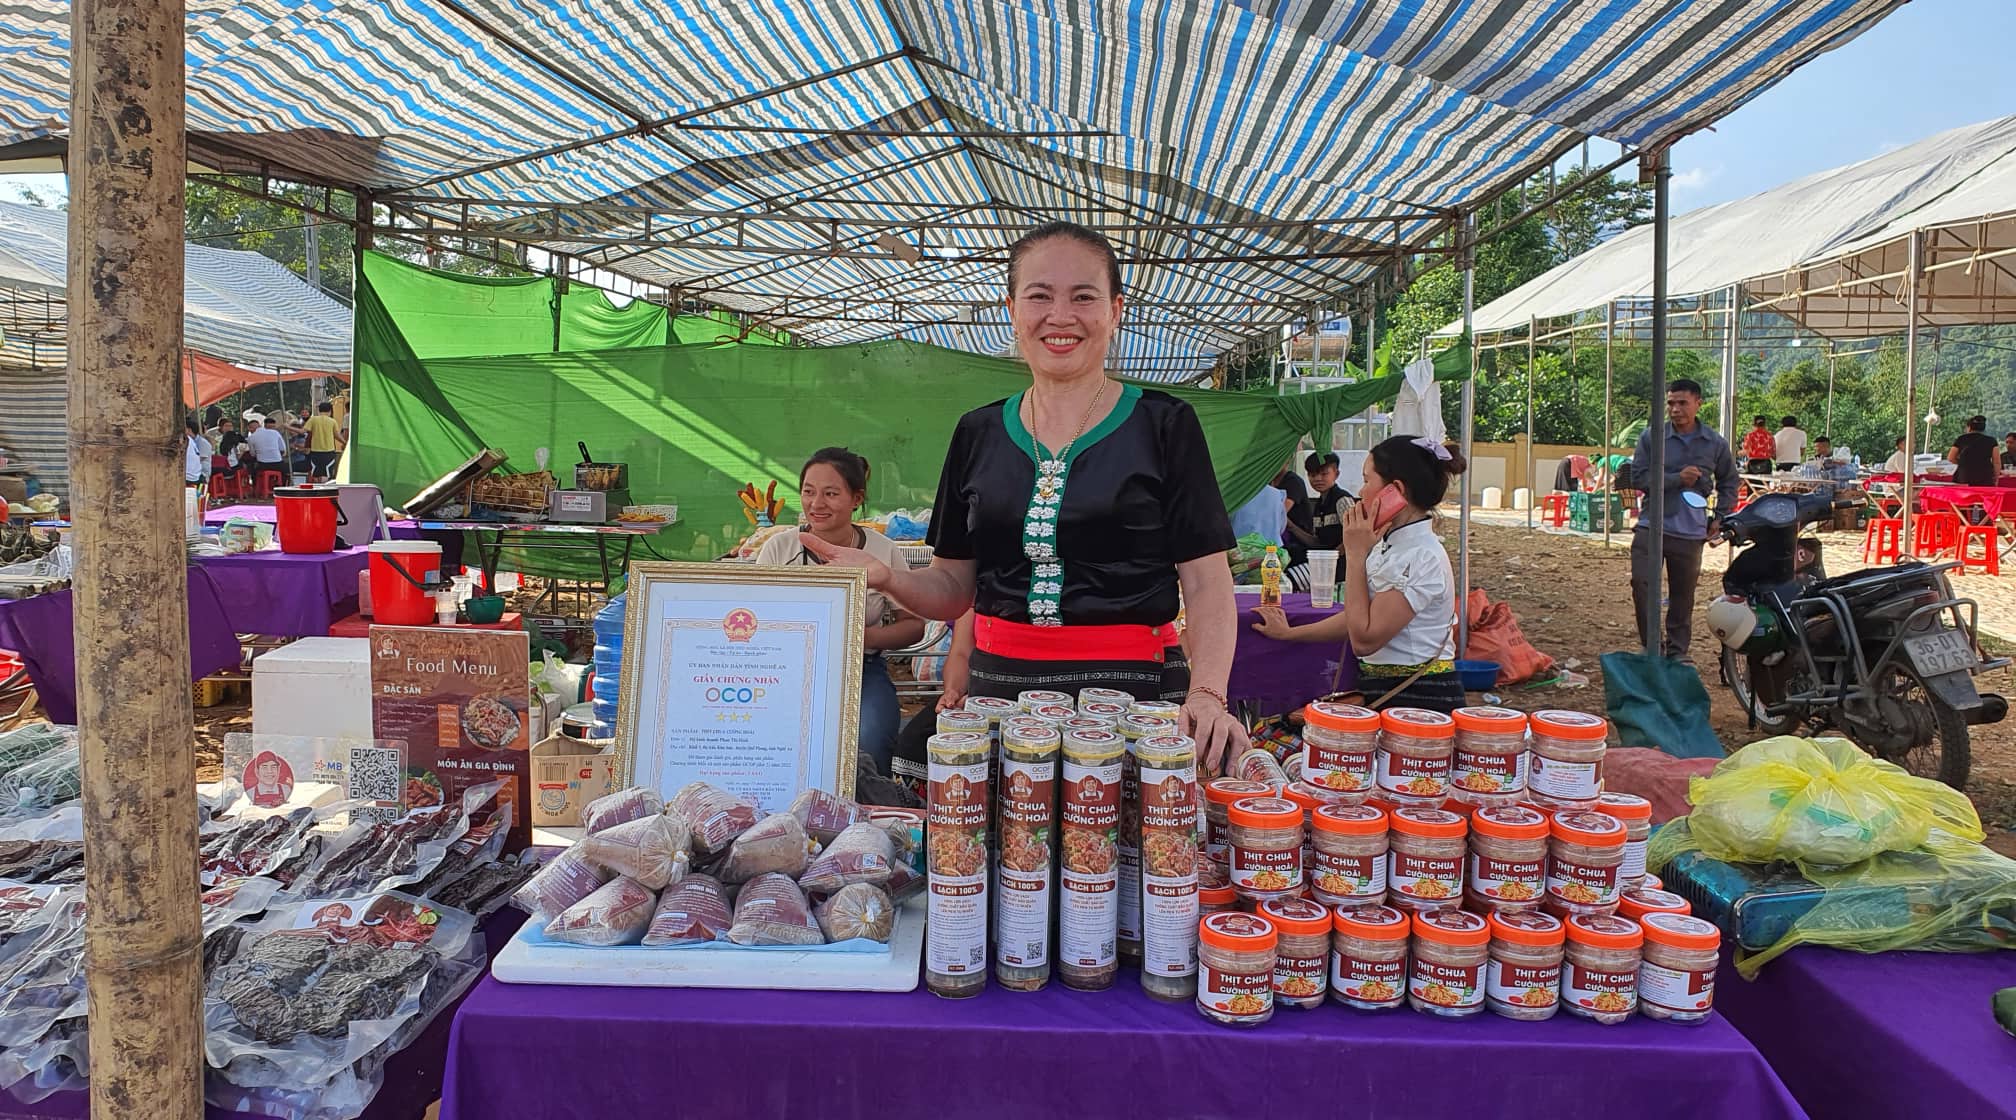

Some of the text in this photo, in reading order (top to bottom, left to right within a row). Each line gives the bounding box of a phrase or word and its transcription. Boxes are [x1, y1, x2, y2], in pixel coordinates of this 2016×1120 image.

[406, 658, 497, 676] Food Menu
[717, 675, 751, 684] CHỨNG
[754, 676, 780, 687] NHẬN
[383, 684, 421, 695] ĐẶC SẢN
[705, 687, 766, 703] OCOP
[1319, 751, 1366, 763] THỊT CHUA
[1459, 752, 1506, 765] THỊT CHUA
[327, 762, 343, 771] MB
[437, 758, 458, 769] MÓN
[475, 761, 490, 770] GIA
[493, 759, 515, 772] ĐÌNH
[1402, 758, 1447, 769] THỊT CHUA
[934, 804, 983, 816] THỊT CHUA
[1018, 802, 1046, 811] CHUA
[1066, 802, 1116, 815] THỊT CHUA
[1148, 803, 1195, 815] THỊT CHUA
[930, 812, 986, 825] CƯỜNG HOÀI
[1063, 812, 1119, 825] CƯỜNG HOÀI
[1244, 852, 1293, 863] THỊT CHUA
[1315, 851, 1360, 867] THỊT CHUA
[1405, 858, 1455, 870] THỊT CHUA
[1489, 861, 1539, 874] THỊT CHUA
[1557, 861, 1607, 878] THỊT CHUA
[959, 886, 978, 894] 100%
[1018, 882, 1037, 890] 100%
[1091, 883, 1109, 891] 100%
[1176, 886, 1194, 895] 100%
[1298, 957, 1322, 967] CHUA
[1351, 960, 1400, 973] THỊT CHUA
[1417, 960, 1466, 978] THỊT CHUA
[1514, 967, 1559, 979] THỊT CHUA
[1220, 974, 1269, 986] THỊT CHUA
[1585, 971, 1607, 983] THỊT
[1609, 974, 1634, 983] CHUA
